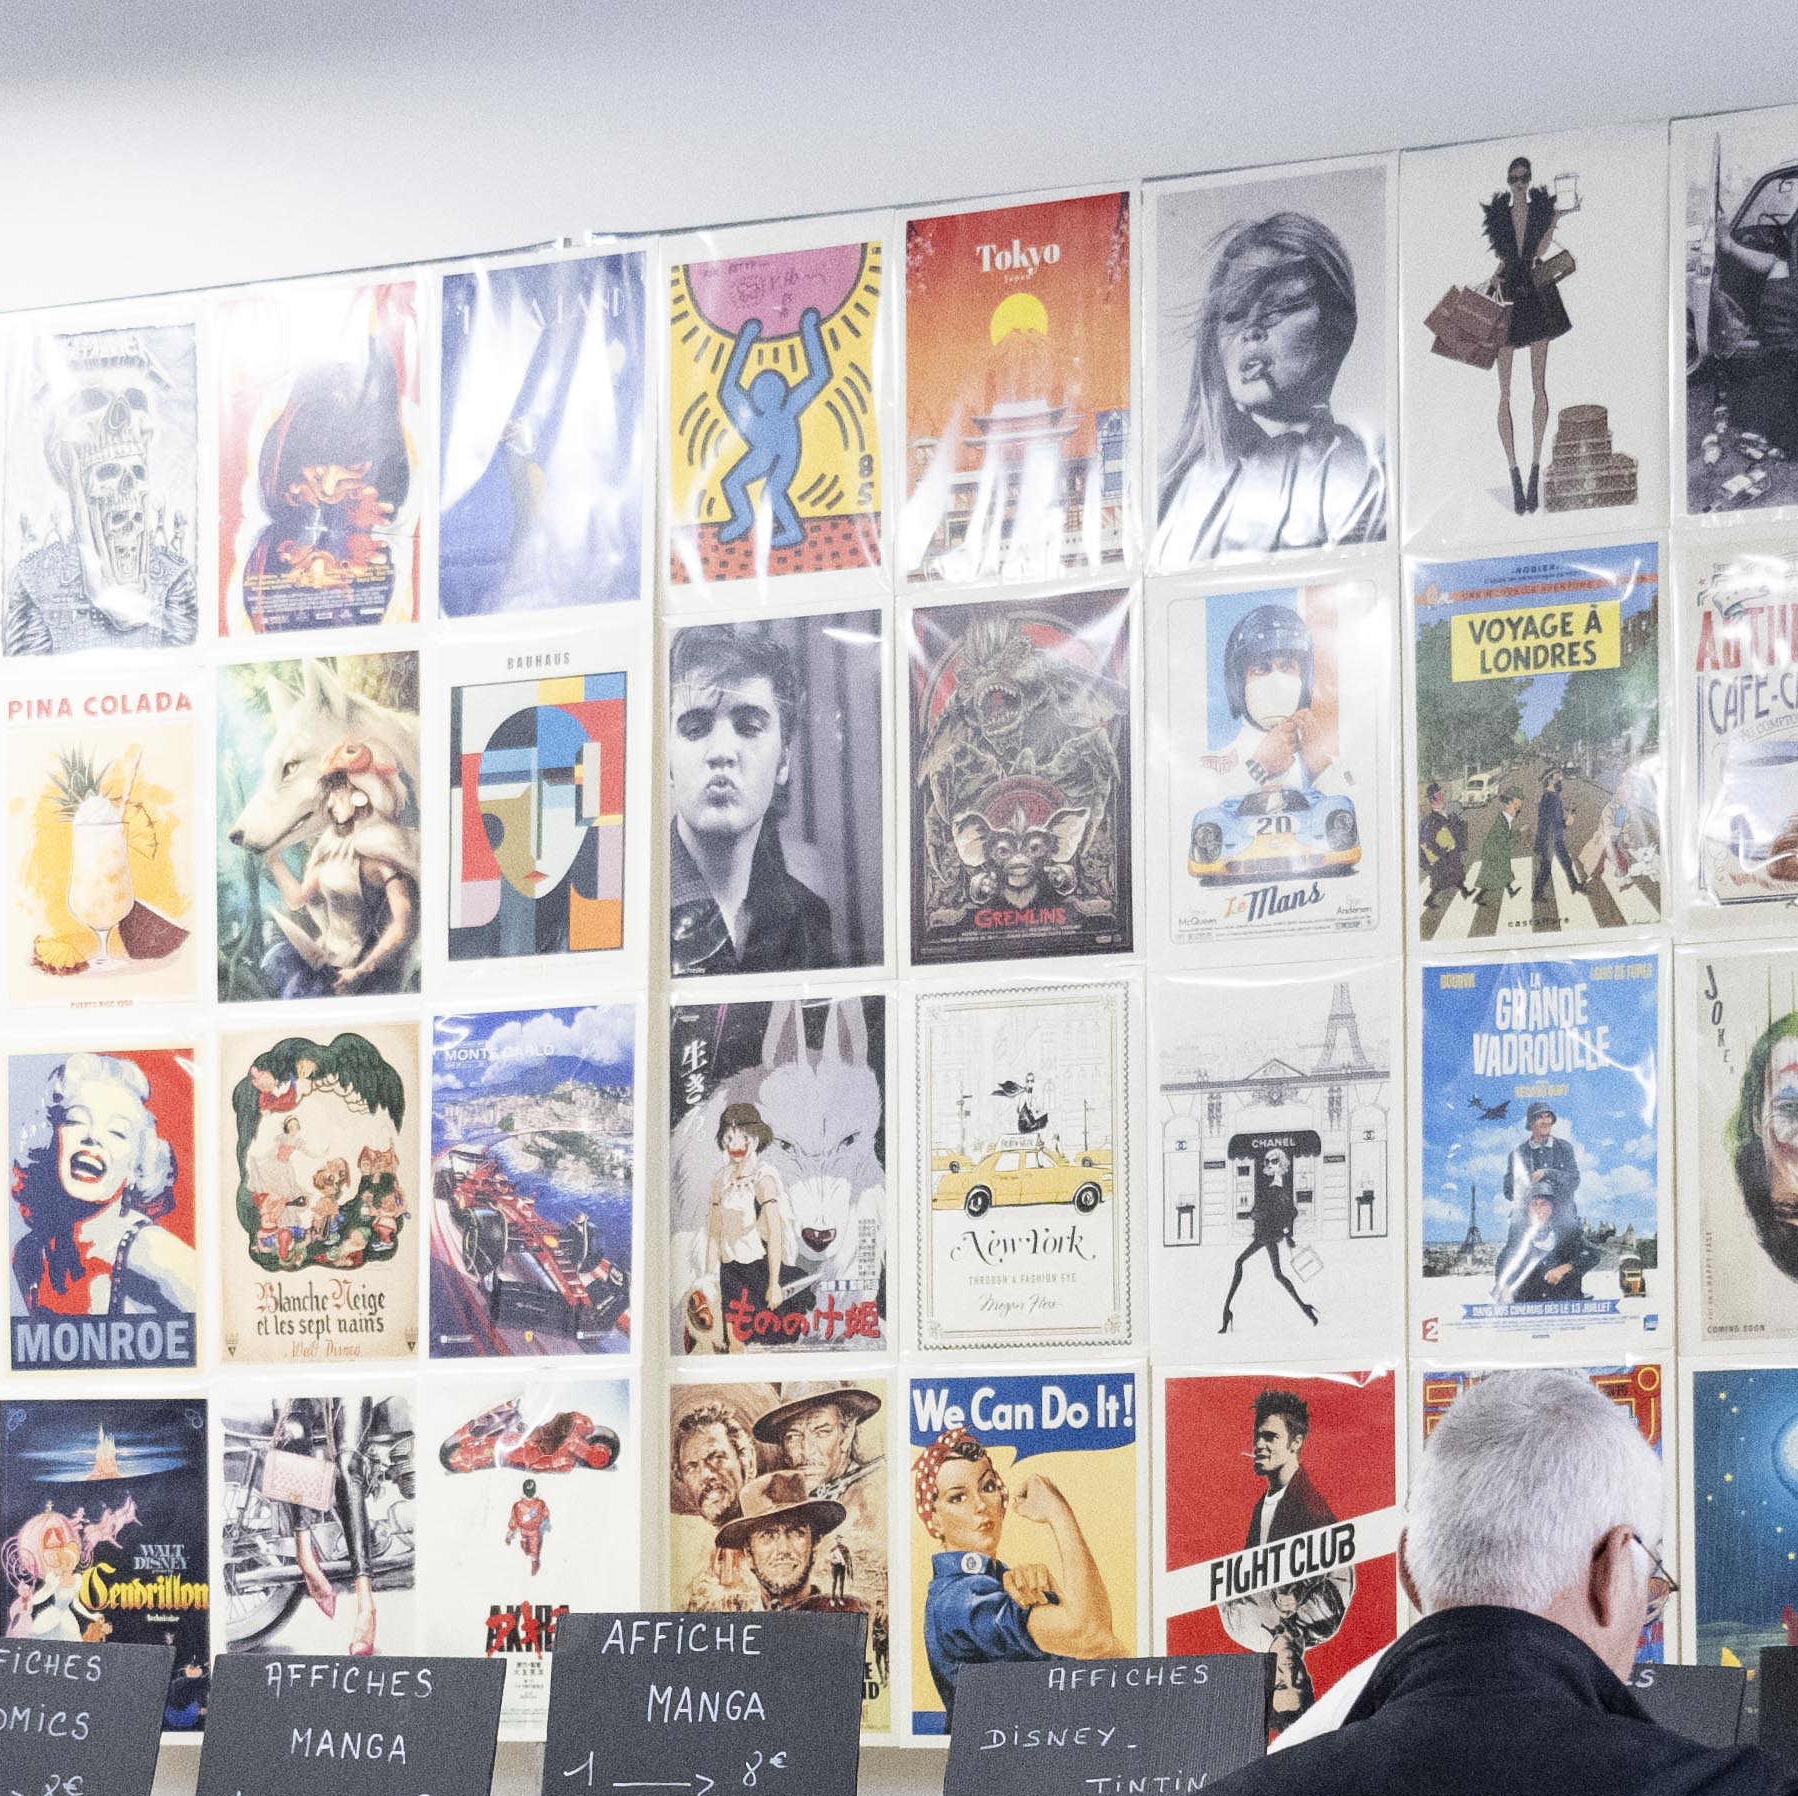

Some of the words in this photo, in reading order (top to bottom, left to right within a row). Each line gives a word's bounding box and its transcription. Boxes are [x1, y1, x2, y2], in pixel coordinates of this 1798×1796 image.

[976, 238, 1062, 276] Tokyo
[1468, 612, 1574, 645] VOYAGE
[1584, 604, 1603, 635] À
[507, 650, 572, 670] BAUHAUS
[1480, 640, 1597, 675] LONDRES
[8, 697, 72, 721] PINA
[84, 692, 193, 717] COLADA
[1257, 816, 1292, 835] 20
[973, 906, 1066, 929] GREMLINS
[1245, 882, 1326, 922] Mans
[1496, 983, 1588, 1031] GRANDE
[1473, 1025, 1611, 1078] VADROUILLE
[1251, 1136, 1297, 1151] CHANEL
[255, 1279, 329, 1314] Blanche
[329, 1278, 385, 1316] Neige
[969, 1274, 1008, 1286] THROUGH
[1020, 1273, 1057, 1285] FASHION
[274, 1315, 295, 1335] les
[300, 1315, 331, 1340] sept
[337, 1316, 385, 1334] nains
[724, 1286, 882, 1342] もののけ姫
[17, 1319, 190, 1363] MONROE
[914, 1386, 966, 1433] We
[970, 1387, 1035, 1431] Can
[1042, 1385, 1091, 1428] Do
[1097, 1382, 1135, 1429] It!
[133, 1556, 188, 1571] DISNEY
[140, 1544, 185, 1558] WALT
[1209, 1543, 1288, 1603] FIGHT
[1289, 1522, 1357, 1579] CLUB
[79, 1562, 209, 1611] Cendrillon
[647, 1684, 767, 1724] MANGA
[290, 1727, 408, 1766] MANGA
